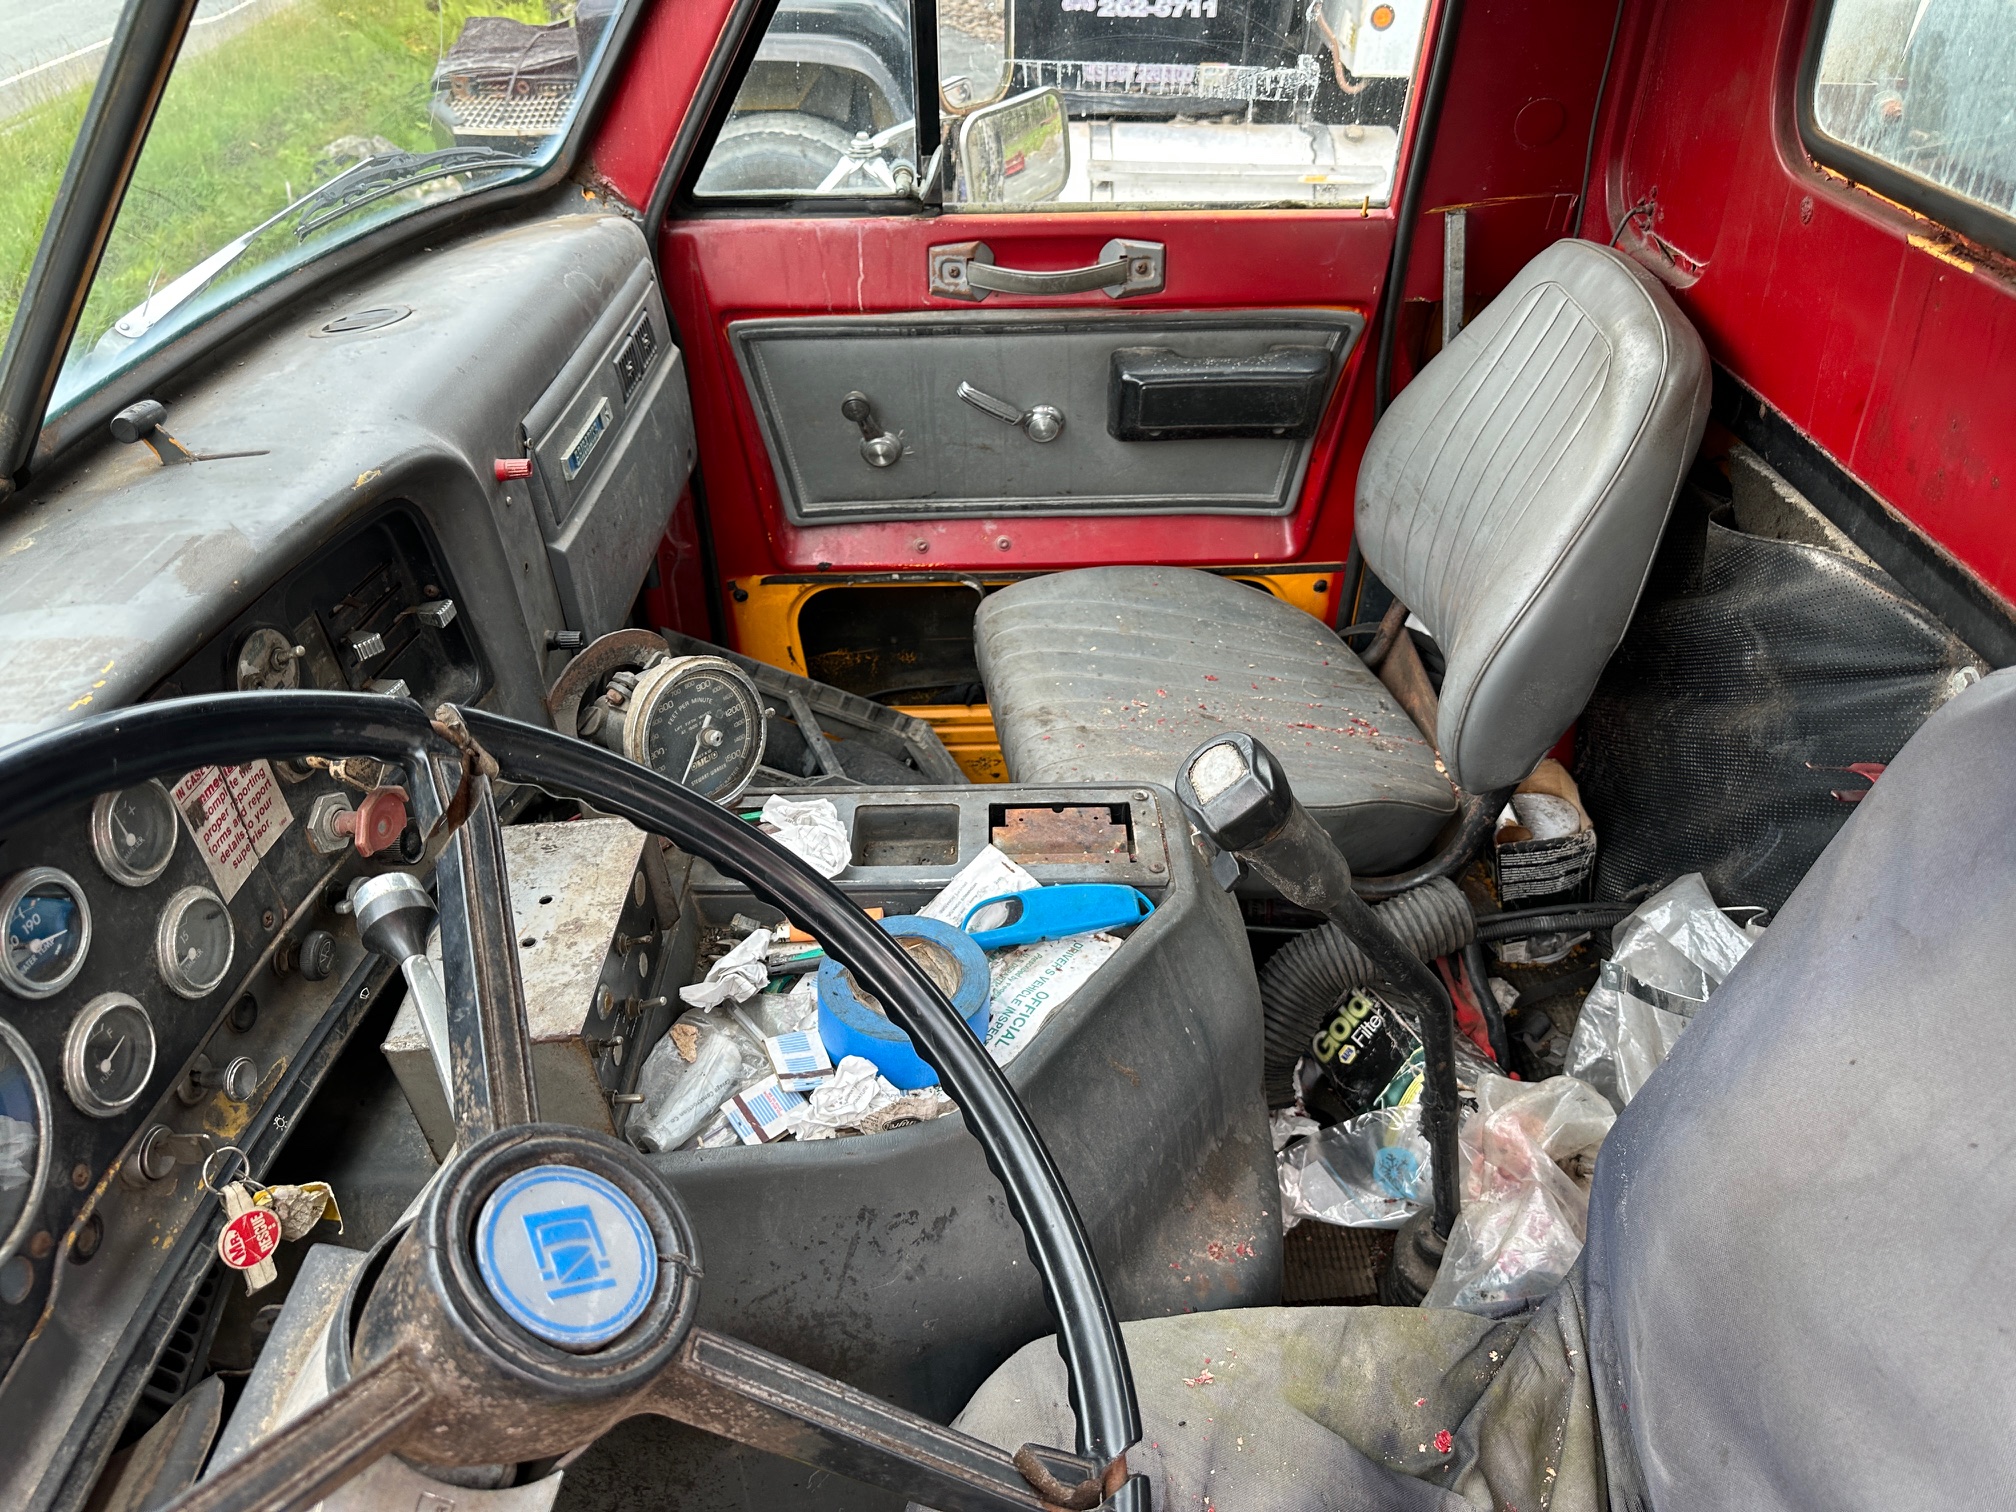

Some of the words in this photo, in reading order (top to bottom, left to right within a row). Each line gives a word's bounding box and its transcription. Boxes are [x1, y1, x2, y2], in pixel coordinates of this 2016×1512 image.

[696, 680, 711, 692] 900
[658, 700, 674, 714] 600
[678, 701, 690, 712] PER
[725, 704, 741, 718] 1200
[175, 787, 186, 802] IN
[185, 768, 205, 791] CASE
[204, 777, 239, 821] complte
[203, 808, 230, 845] proper
[208, 826, 232, 857] forms
[248, 778, 272, 809] report
[220, 829, 245, 864] details
[254, 796, 273, 823] your
[232, 818, 273, 869] supevisor.
[21, 913, 41, 935] 190
[1011, 976, 1050, 1007] VEHICLE
[106, 1027, 114, 1039] F
[996, 991, 1050, 1047] OFFICIAL
[1313, 987, 1374, 1064] Gold
[99, 1068, 115, 1084] FUEL
[250, 1212, 274, 1253] RESCUE
